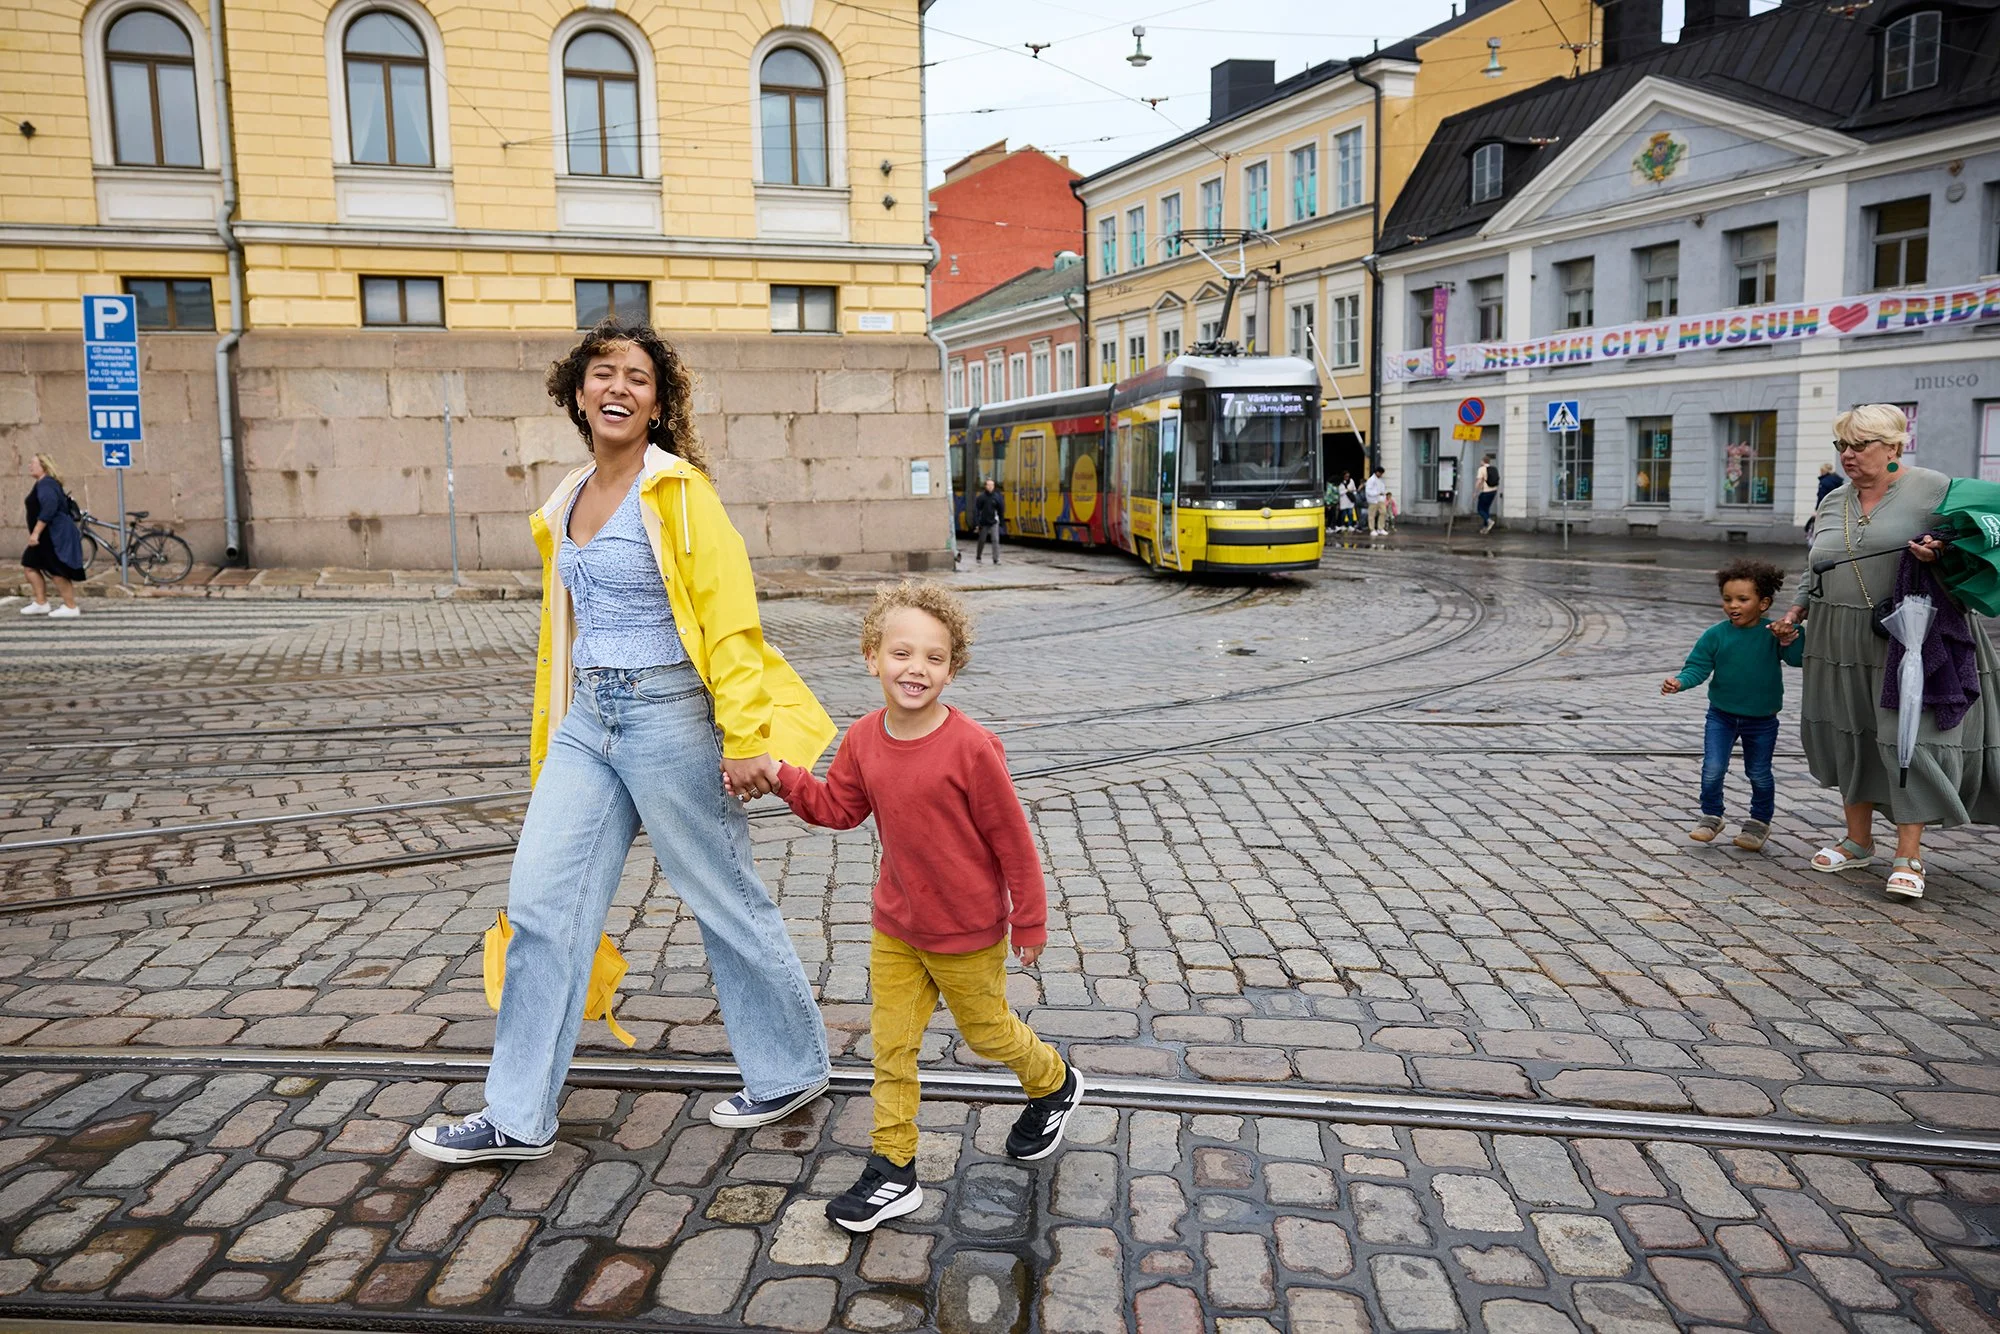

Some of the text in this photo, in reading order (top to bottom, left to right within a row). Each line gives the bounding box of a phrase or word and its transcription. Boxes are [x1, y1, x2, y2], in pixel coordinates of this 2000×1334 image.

[93, 298, 127, 339] P
[1483, 335, 1594, 369] HELSINKI
[1601, 323, 1669, 357] CITY
[1678, 307, 1820, 349] MUSEUM
[1876, 287, 2000, 330] PRIDE
[1434, 312, 1444, 371] MUSEO
[1914, 373, 1979, 390] museo
[1245, 404, 1257, 413] via
[1247, 394, 1279, 403] Västra
